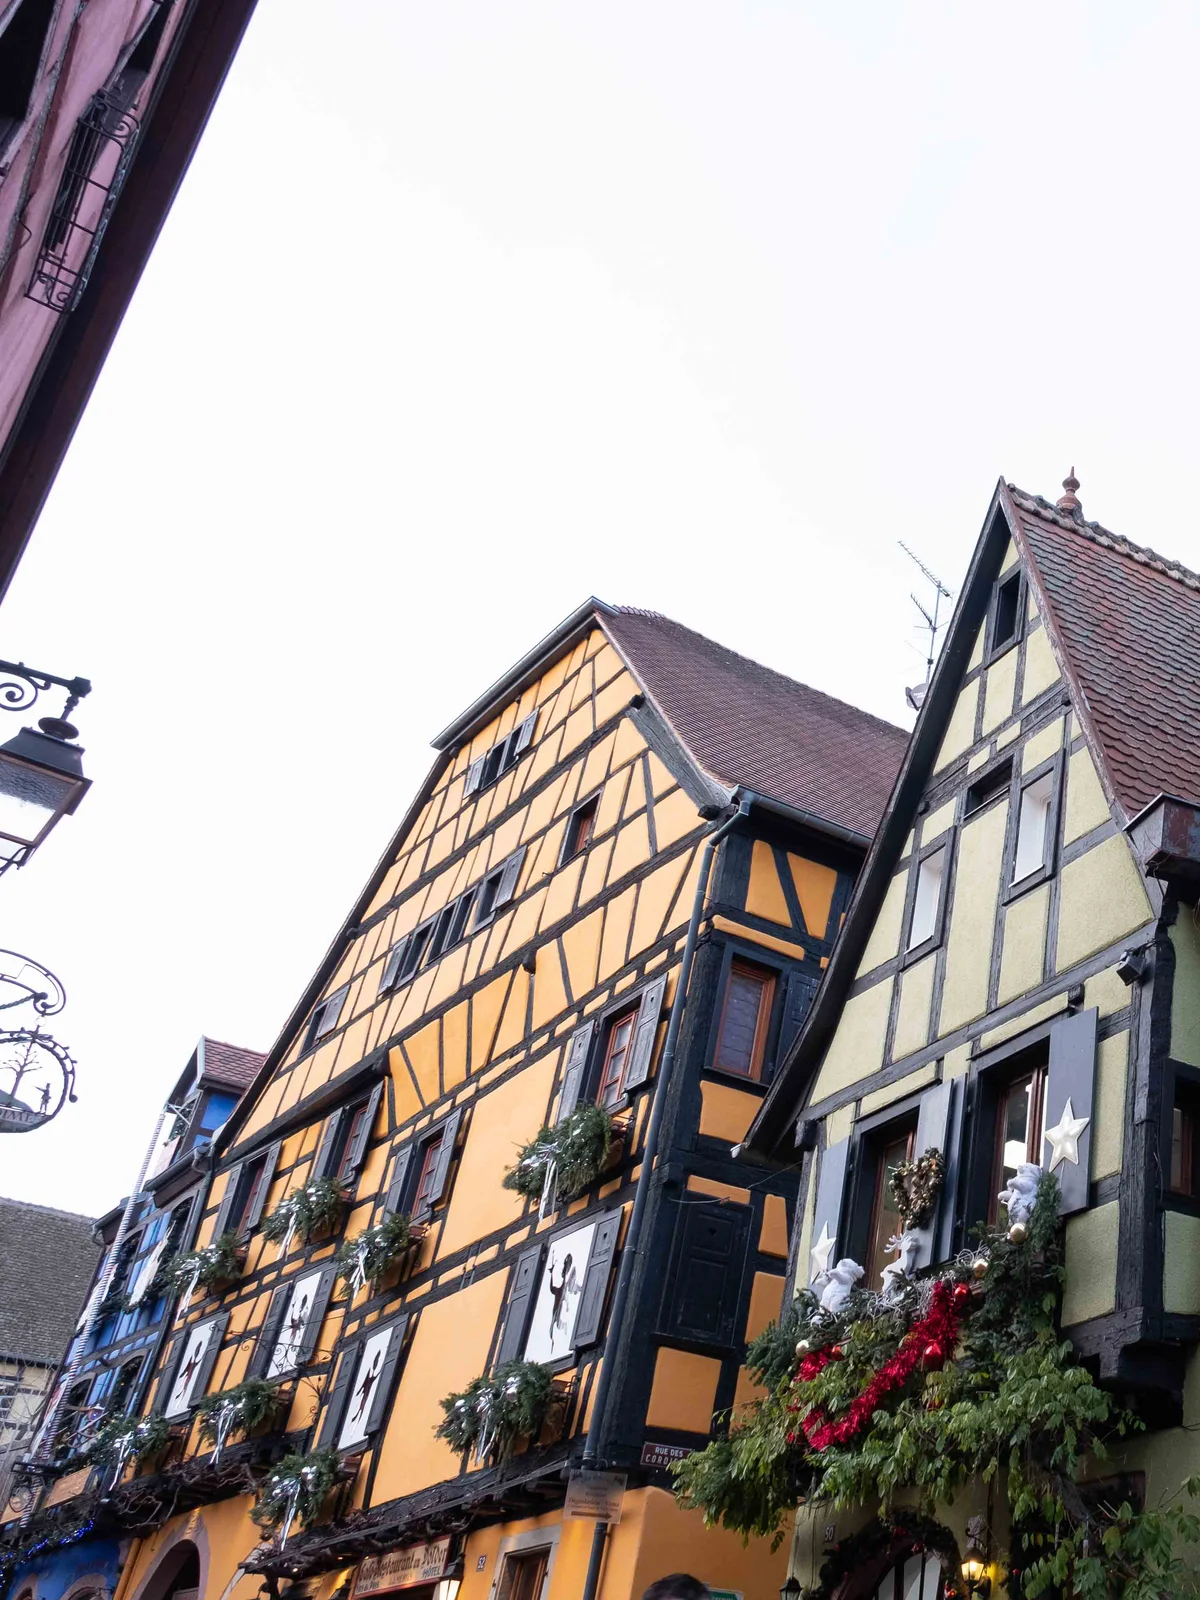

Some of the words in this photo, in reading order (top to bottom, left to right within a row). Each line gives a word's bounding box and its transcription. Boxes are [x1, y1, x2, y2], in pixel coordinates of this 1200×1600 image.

[655, 1447, 669, 1455] RUE
[670, 1449, 684, 1458] DES
[825, 1526, 834, 1541] 50
